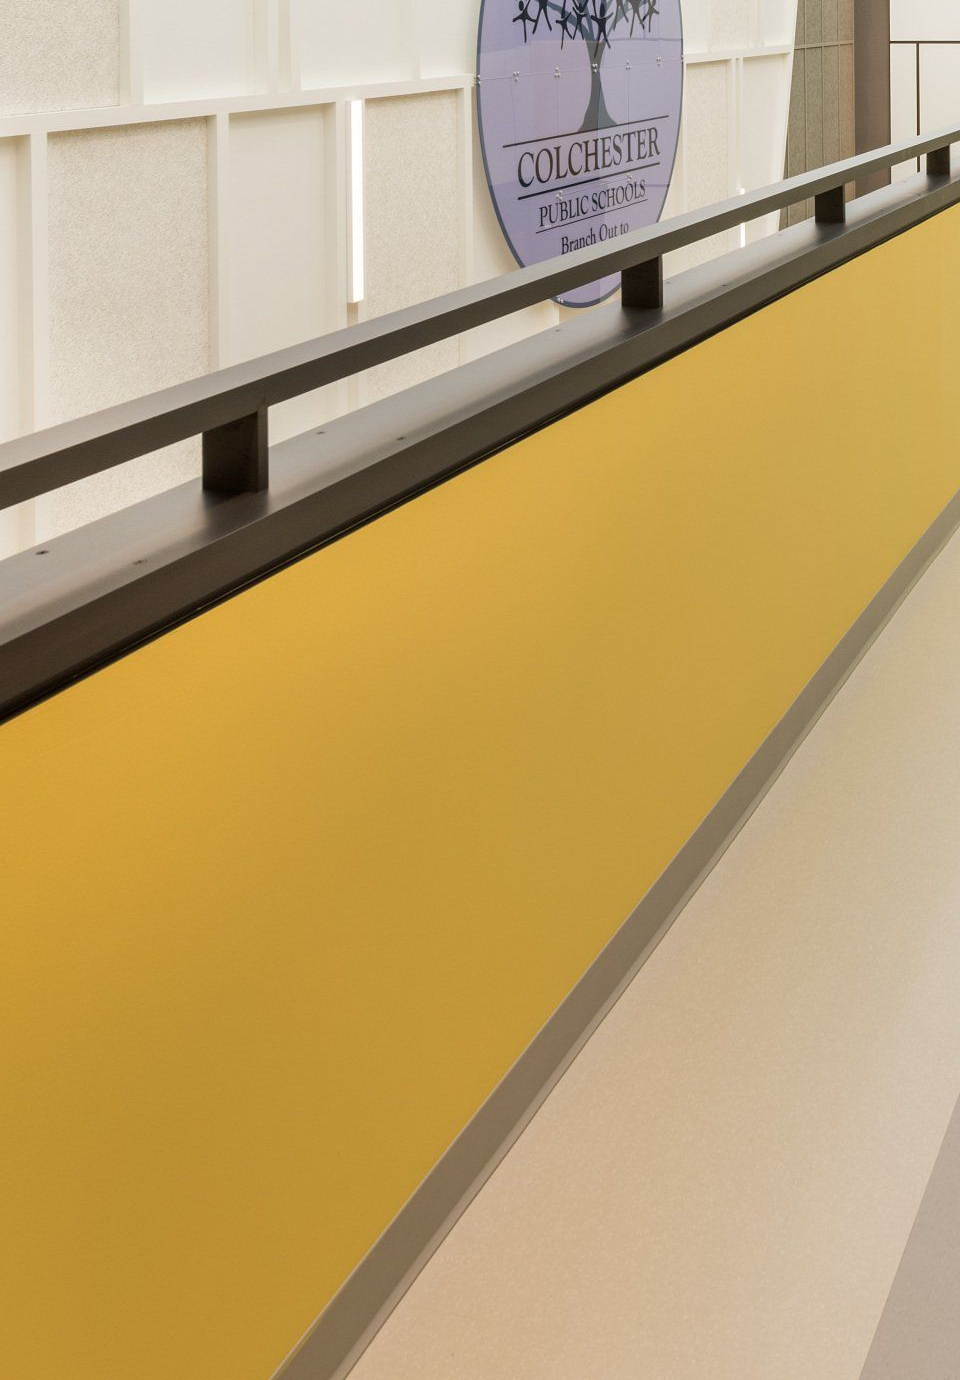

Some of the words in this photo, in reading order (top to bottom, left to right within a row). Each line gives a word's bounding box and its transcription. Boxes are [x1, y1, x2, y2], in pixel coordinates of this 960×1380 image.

[517, 127, 661, 188] COLCHESTER
[538, 196, 589, 227] PUBLIC
[591, 179, 646, 212] SCHOOLS
[560, 231, 597, 255] Branch
[599, 223, 618, 241] Out
[620, 221, 630, 234] to
